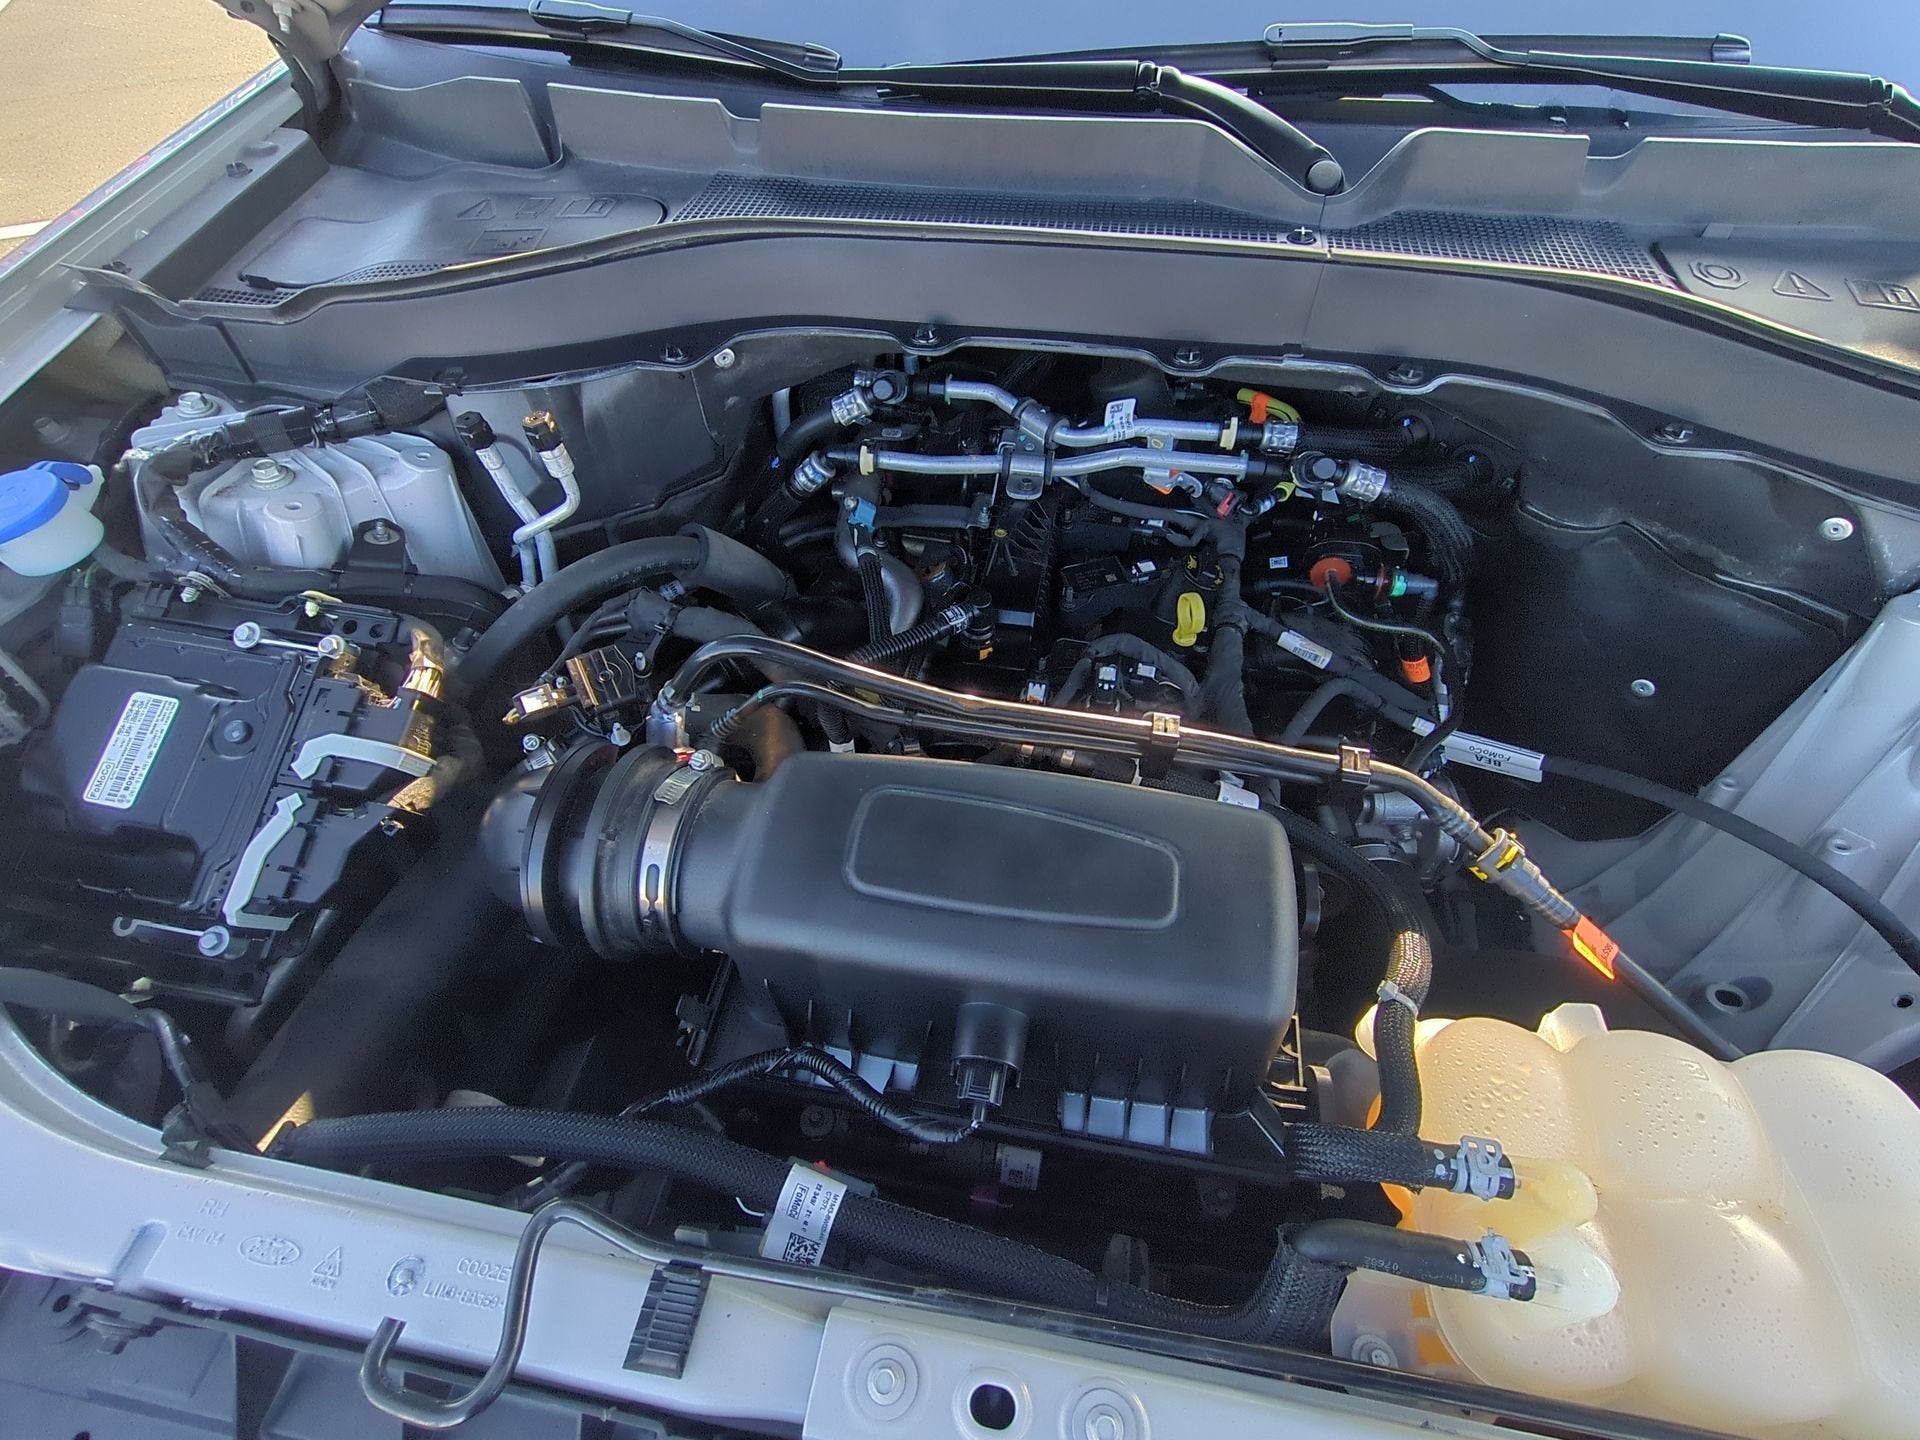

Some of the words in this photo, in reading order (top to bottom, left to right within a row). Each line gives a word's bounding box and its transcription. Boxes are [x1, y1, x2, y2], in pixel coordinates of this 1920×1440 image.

[1469, 745, 1511, 761] FoMoCo
[1474, 754, 1502, 768] BEA
[89, 764, 112, 798] FoMoCo
[123, 765, 141, 791] BOSCH
[788, 1186, 807, 1218] FoMoCo
